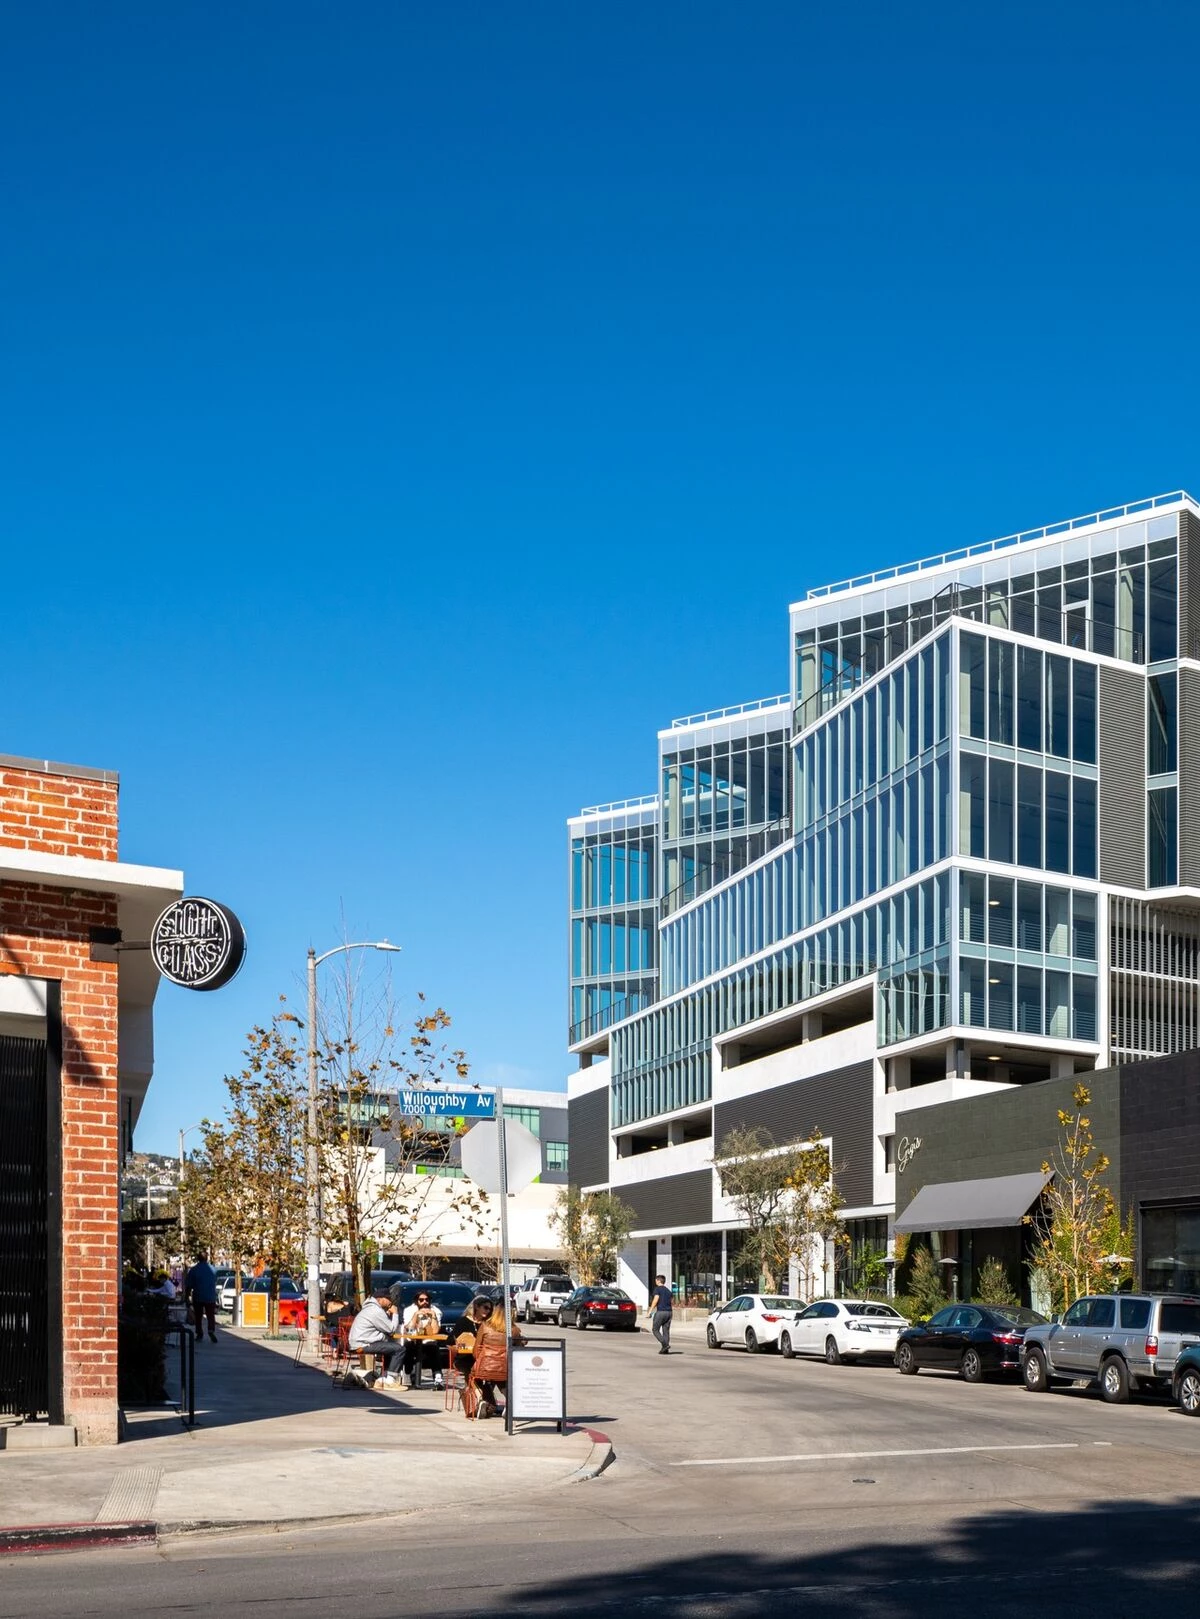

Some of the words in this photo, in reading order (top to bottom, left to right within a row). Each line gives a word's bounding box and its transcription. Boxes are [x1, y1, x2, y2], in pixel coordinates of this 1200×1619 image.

[403, 1091, 466, 1110] Willoughby
[476, 1094, 491, 1107] Av
[403, 1104, 426, 1114] 7000
[429, 1105, 437, 1114] W
